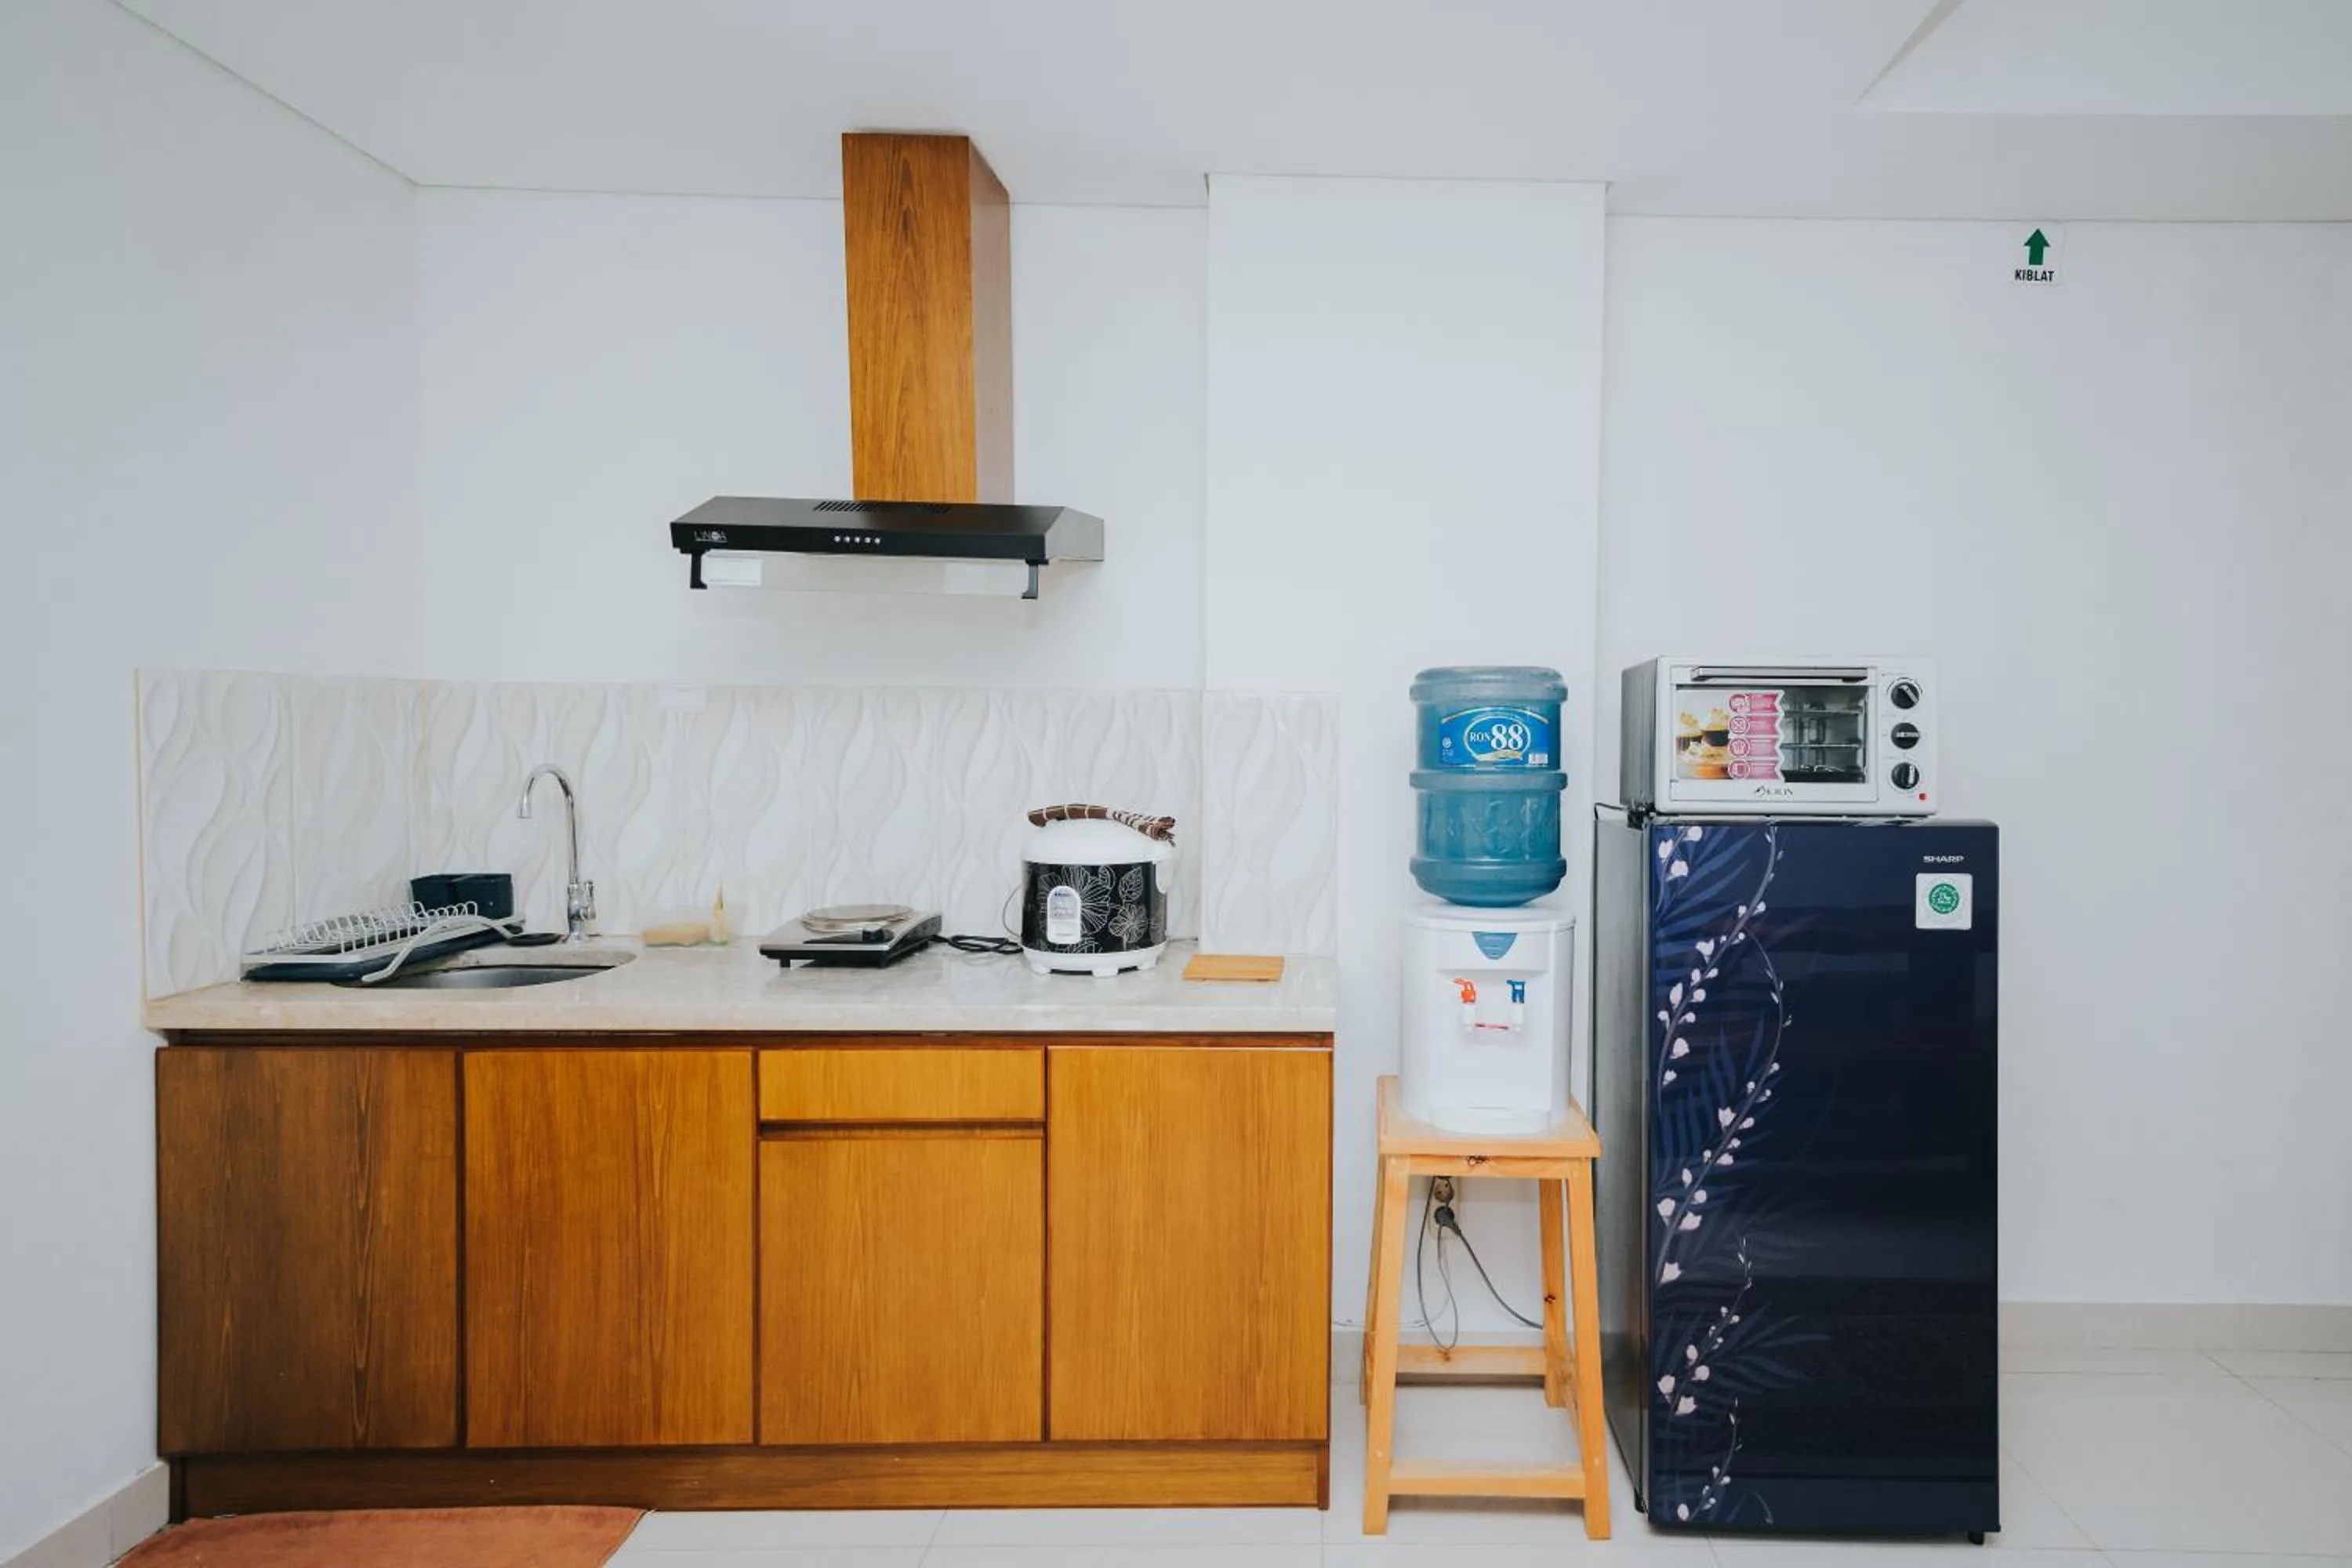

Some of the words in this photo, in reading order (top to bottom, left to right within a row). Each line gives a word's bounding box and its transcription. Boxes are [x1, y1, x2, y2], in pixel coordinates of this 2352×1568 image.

[2015, 269, 2054, 281] KIBLAT
[1470, 732, 1491, 742] RON
[1491, 724, 1523, 750] 88
